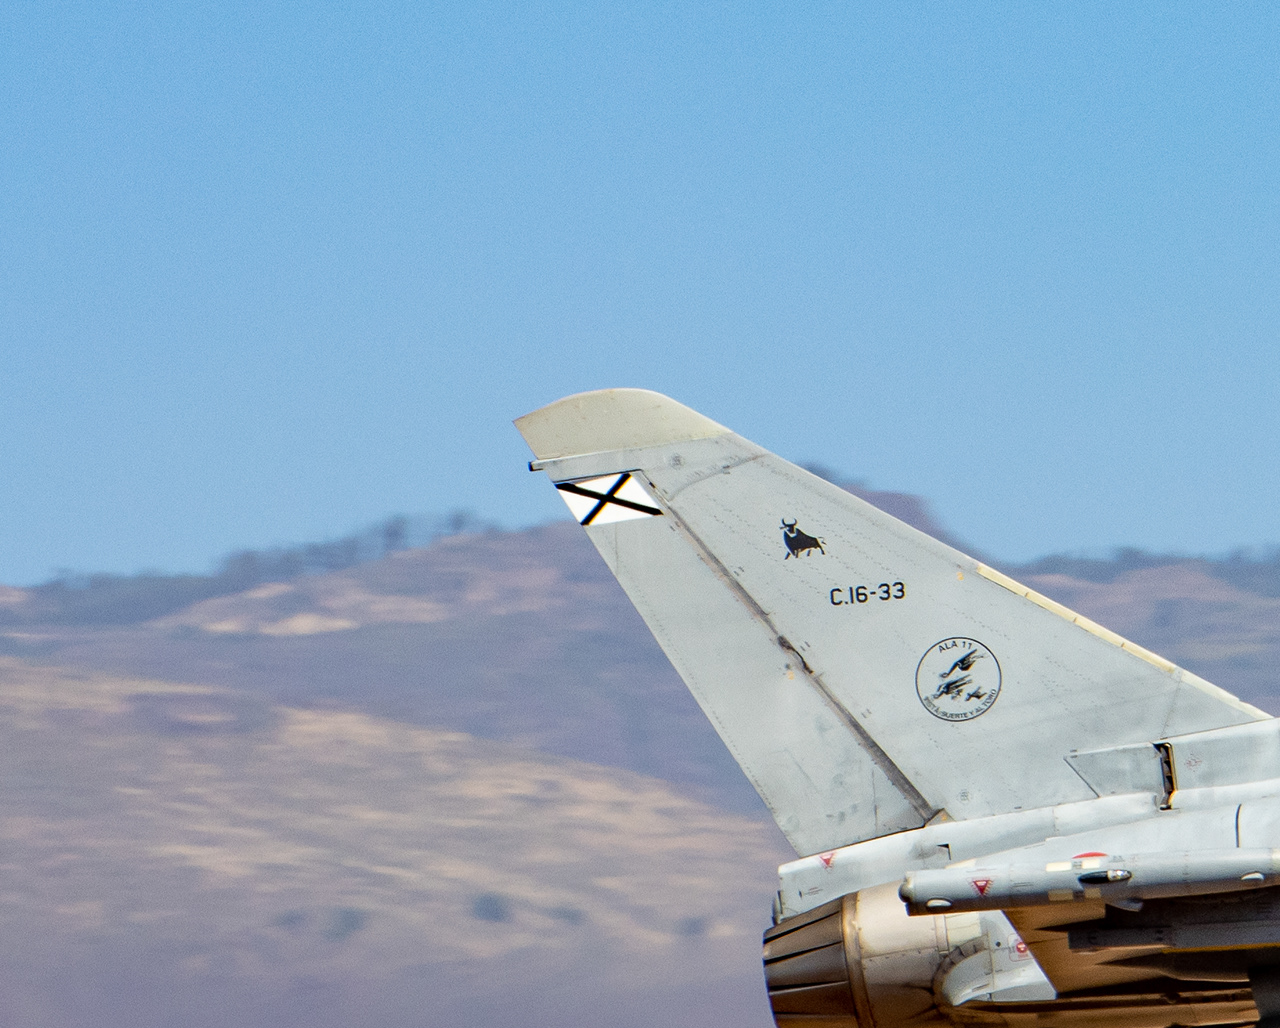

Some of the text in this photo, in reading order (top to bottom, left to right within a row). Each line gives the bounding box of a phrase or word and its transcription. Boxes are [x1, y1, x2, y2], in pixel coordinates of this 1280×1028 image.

[830, 581, 906, 606] C.16-33
[938, 640, 972, 653] ALA 11
